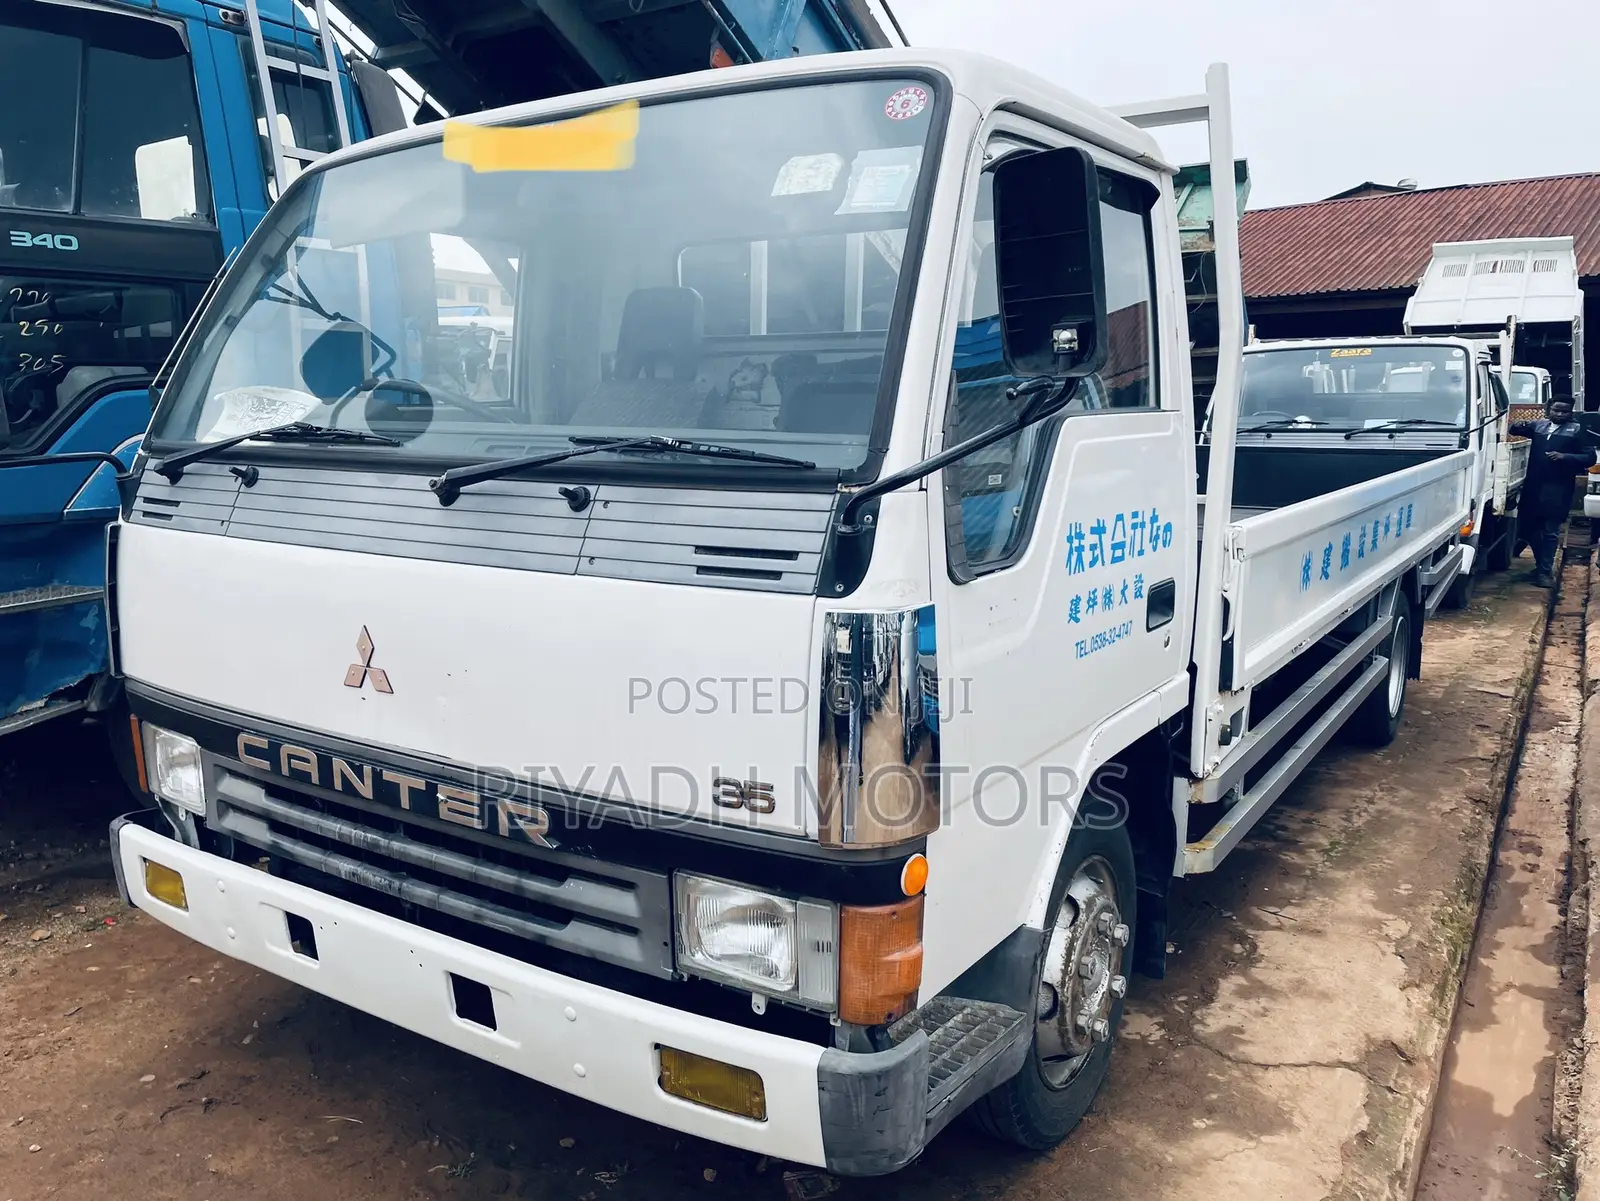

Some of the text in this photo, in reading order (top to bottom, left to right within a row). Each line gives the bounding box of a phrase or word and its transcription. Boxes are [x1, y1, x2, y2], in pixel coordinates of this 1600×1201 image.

[901, 99, 912, 109] 6
[9, 230, 79, 250] 340
[237, 732, 559, 849] CANTER
[712, 776, 775, 814] 35
